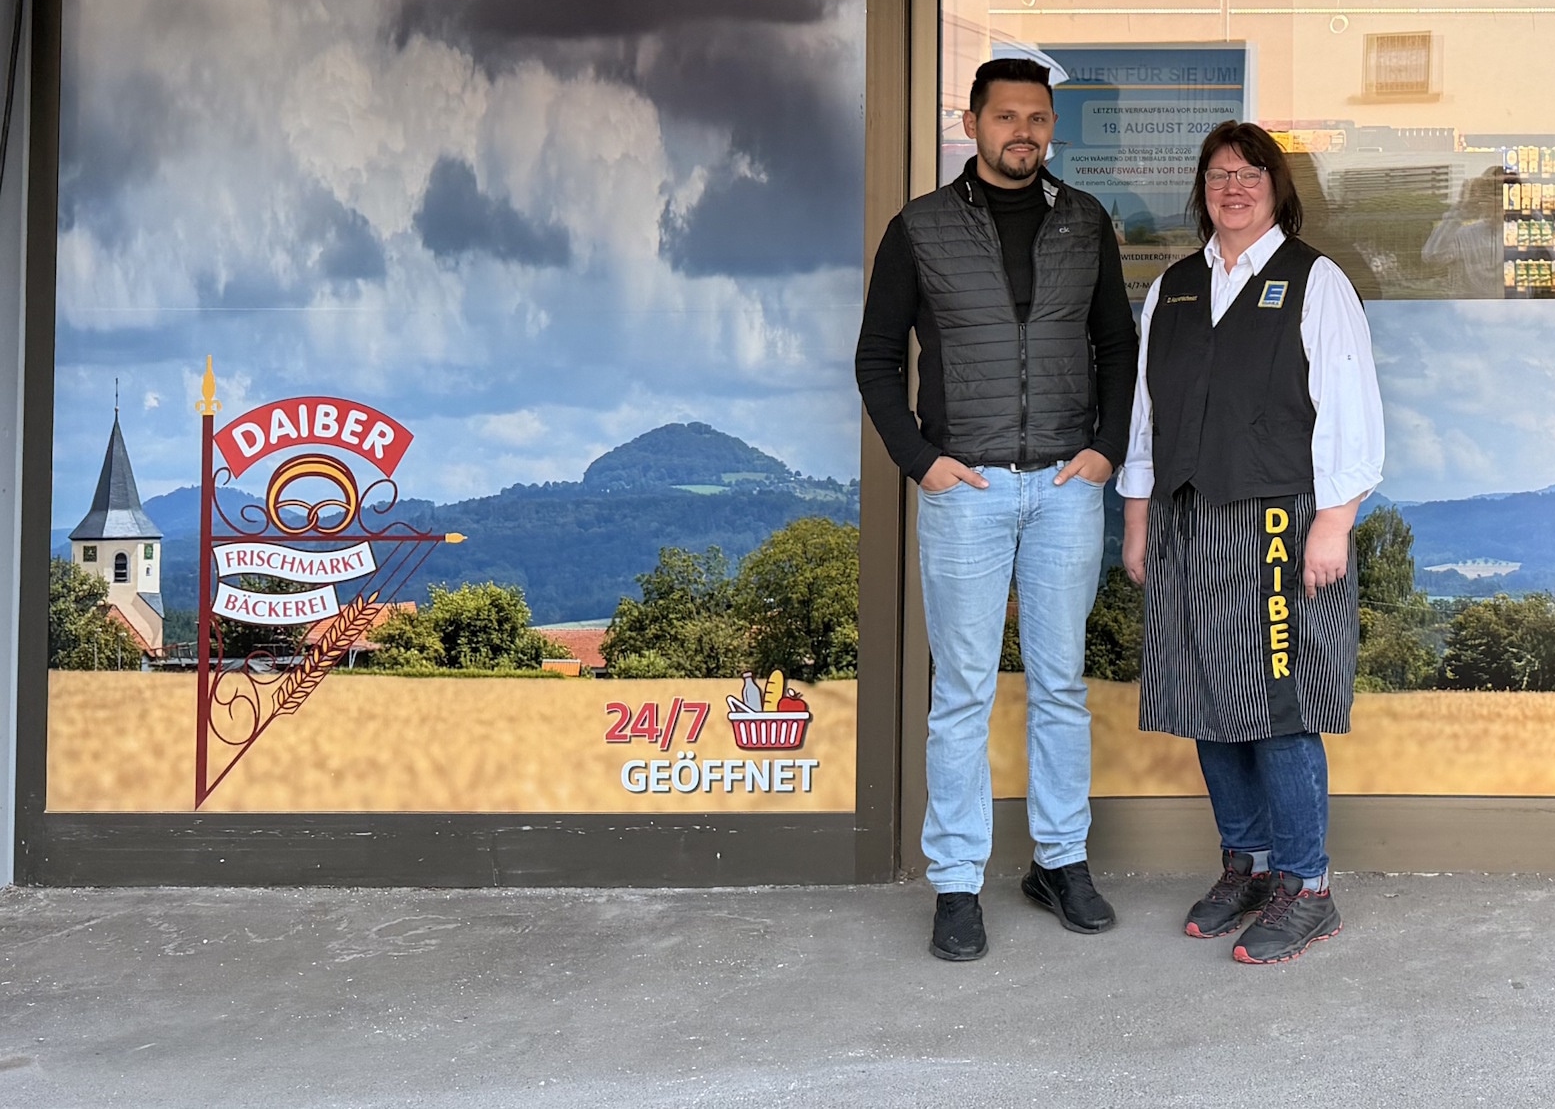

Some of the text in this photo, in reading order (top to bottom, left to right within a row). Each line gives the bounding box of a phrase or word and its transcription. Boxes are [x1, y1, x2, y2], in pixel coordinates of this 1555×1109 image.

[1069, 64, 1238, 82] AUEN FÜR SIE UM!
[1102, 122, 1121, 134] 19.
[1125, 122, 1183, 134] AUGUST
[1128, 147, 1154, 156] Montag
[1076, 166, 1196, 175] VERKAUFSWAGEN VOR DEM
[231, 403, 395, 460] DAIBER
[225, 546, 367, 576] FRISCHMARKT
[224, 592, 328, 618] BÄCKEREI
[1265, 507, 1291, 680] DAIBER
[605, 697, 709, 751] 24/7
[621, 751, 819, 793] GEÖFFNET
